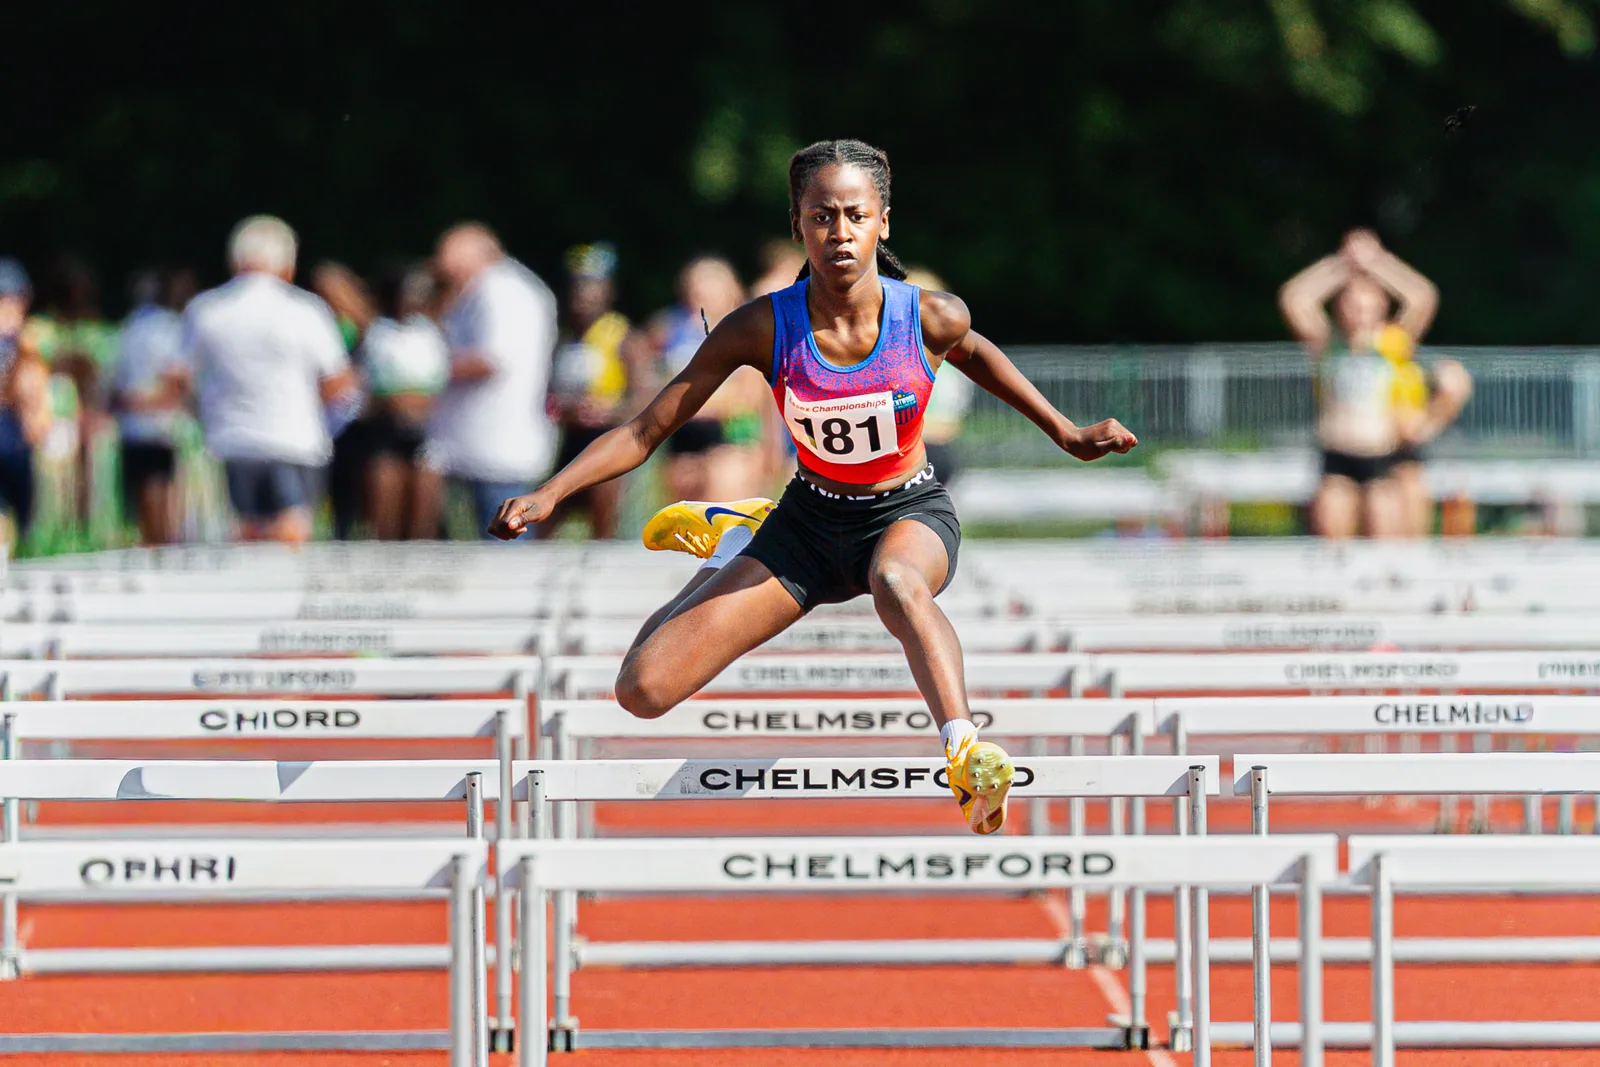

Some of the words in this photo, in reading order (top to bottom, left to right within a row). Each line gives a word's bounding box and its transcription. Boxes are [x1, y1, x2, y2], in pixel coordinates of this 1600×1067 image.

[812, 399, 887, 412] Championships
[794, 415, 882, 455] 181
[703, 711, 993, 730] CHELMSFOD
[699, 767, 1035, 791] CHELMSFD
[723, 853, 1114, 879] CHELMSFORD
